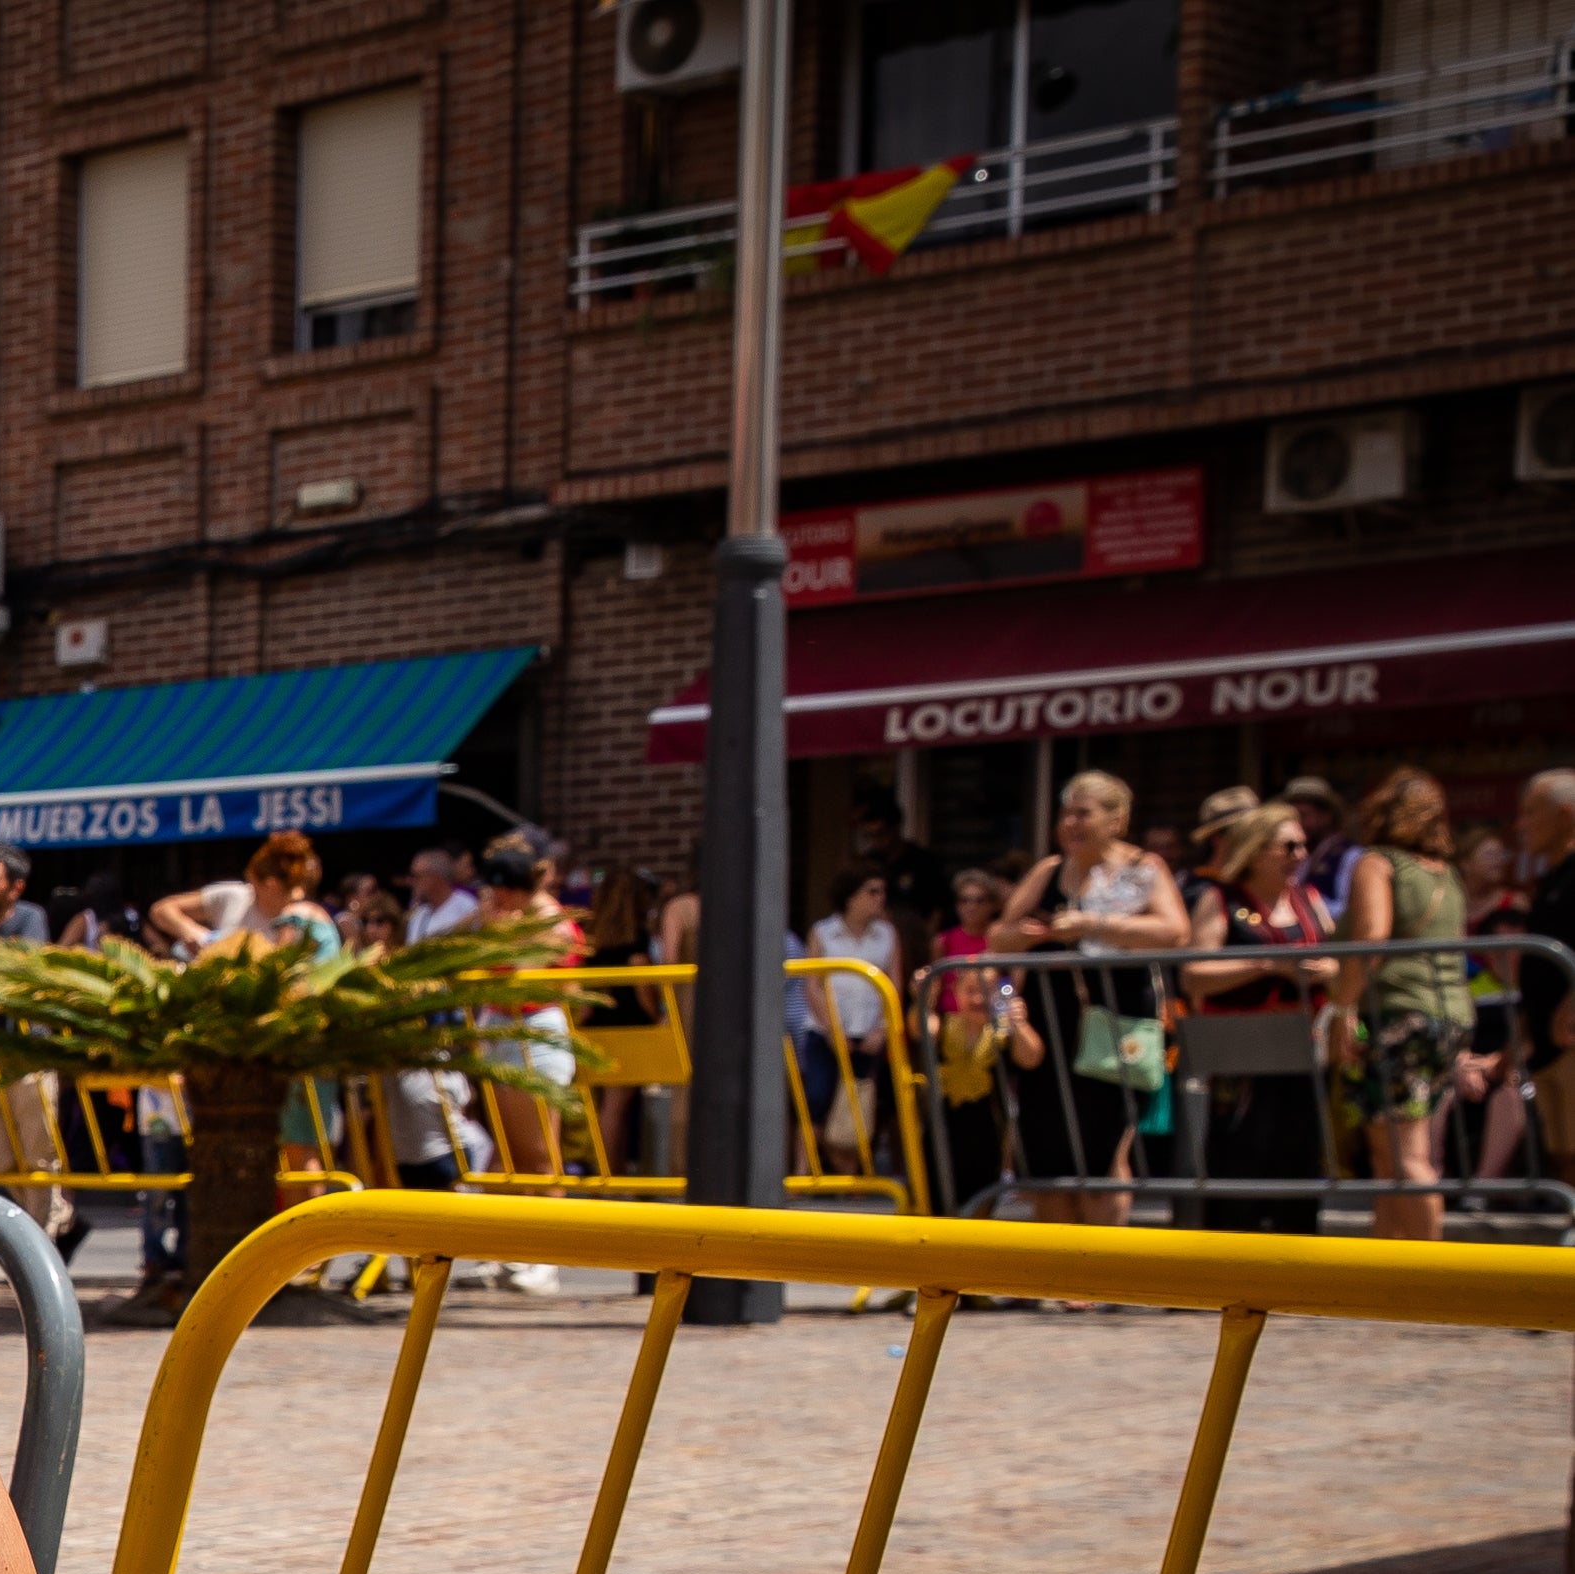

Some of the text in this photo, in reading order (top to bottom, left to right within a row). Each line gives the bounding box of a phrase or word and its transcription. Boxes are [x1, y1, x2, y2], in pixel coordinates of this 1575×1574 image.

[781, 556, 851, 593] OUR
[884, 663, 1380, 743] LOCUTORIO NOUR
[179, 795, 224, 835] LA
[252, 785, 343, 830] JESSI
